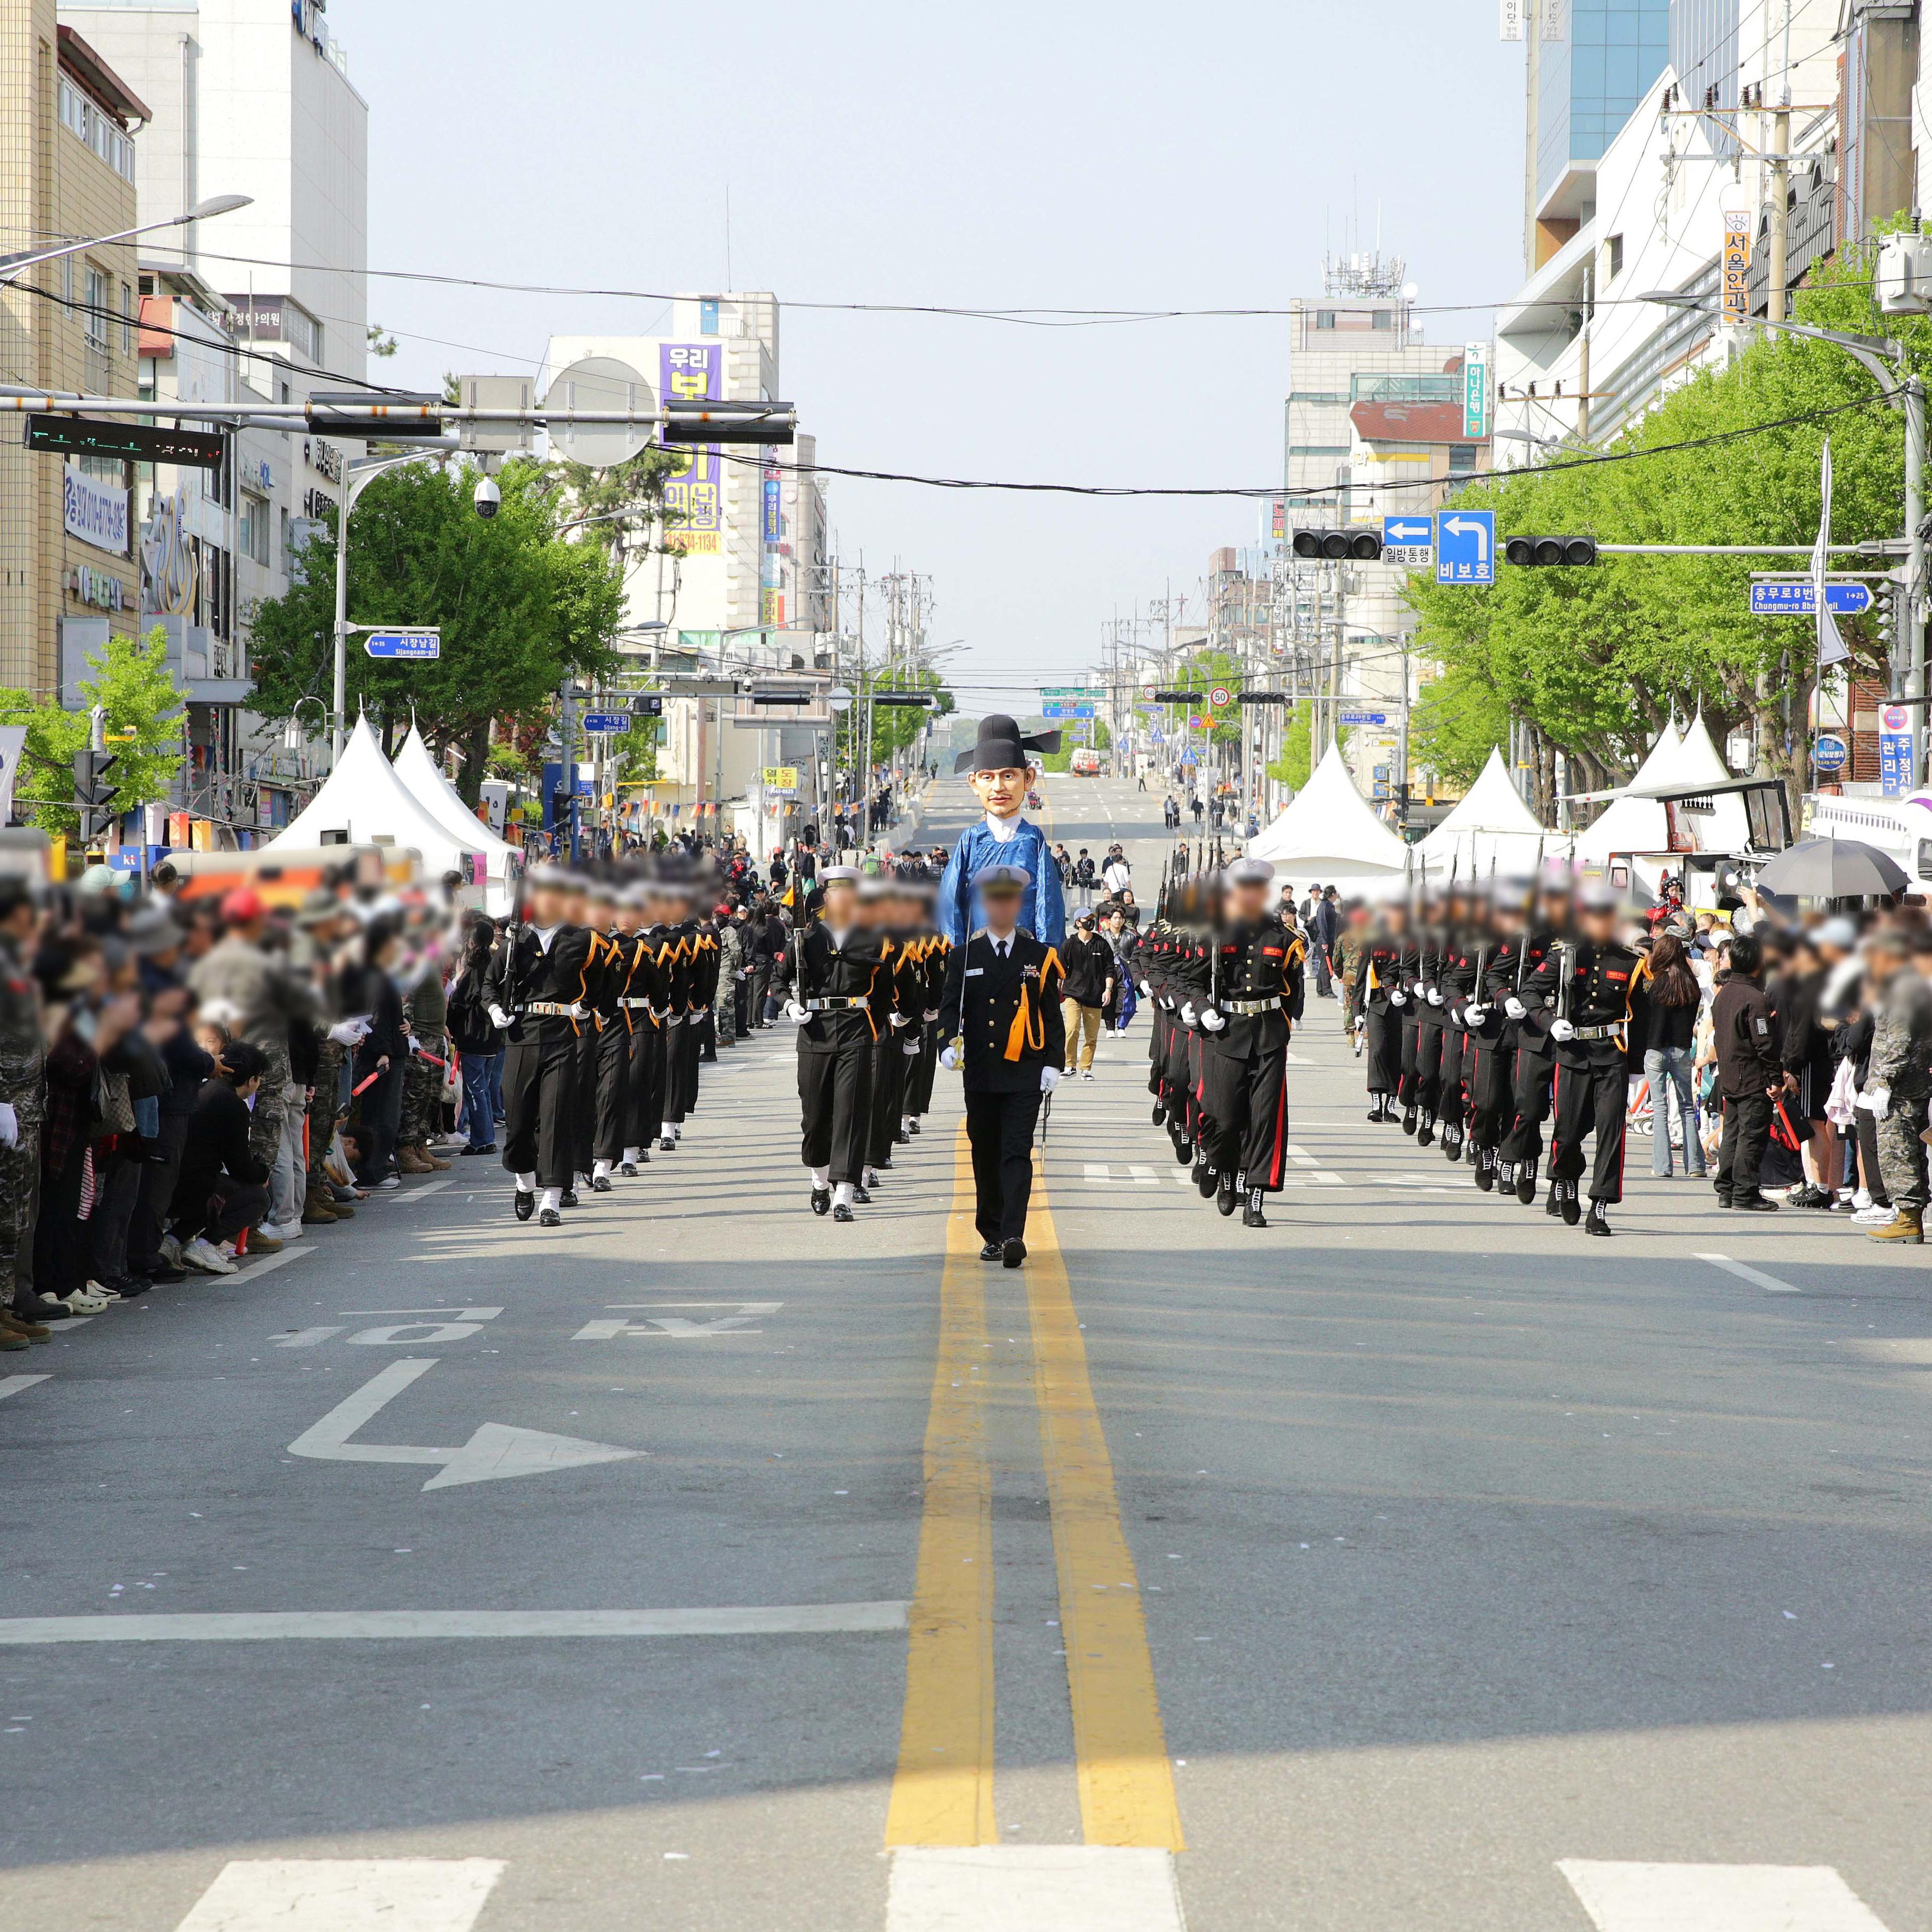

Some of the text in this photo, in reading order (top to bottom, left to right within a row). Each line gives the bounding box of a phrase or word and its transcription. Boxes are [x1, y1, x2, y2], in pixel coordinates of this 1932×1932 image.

[1507, 0, 1516, 24] 이닷
[1727, 235, 1746, 307] 서울안과
[669, 348, 708, 369] 우리
[1470, 366, 1481, 414] 하나은행
[695, 487, 714, 525] 난청
[1387, 547, 1429, 562] 일방통행
[1440, 561, 1490, 579] 비보호
[1755, 587, 1826, 601] 충무로8번
[1754, 602, 1799, 610] Chungmu-ro
[400, 638, 436, 649] 시장남길
[1215, 693, 1225, 701] 50
[605, 716, 628, 725] 시장길
[1882, 742, 1897, 791] 관리구
[781, 769, 792, 787] 도장
[123, 854, 137, 865] kt
